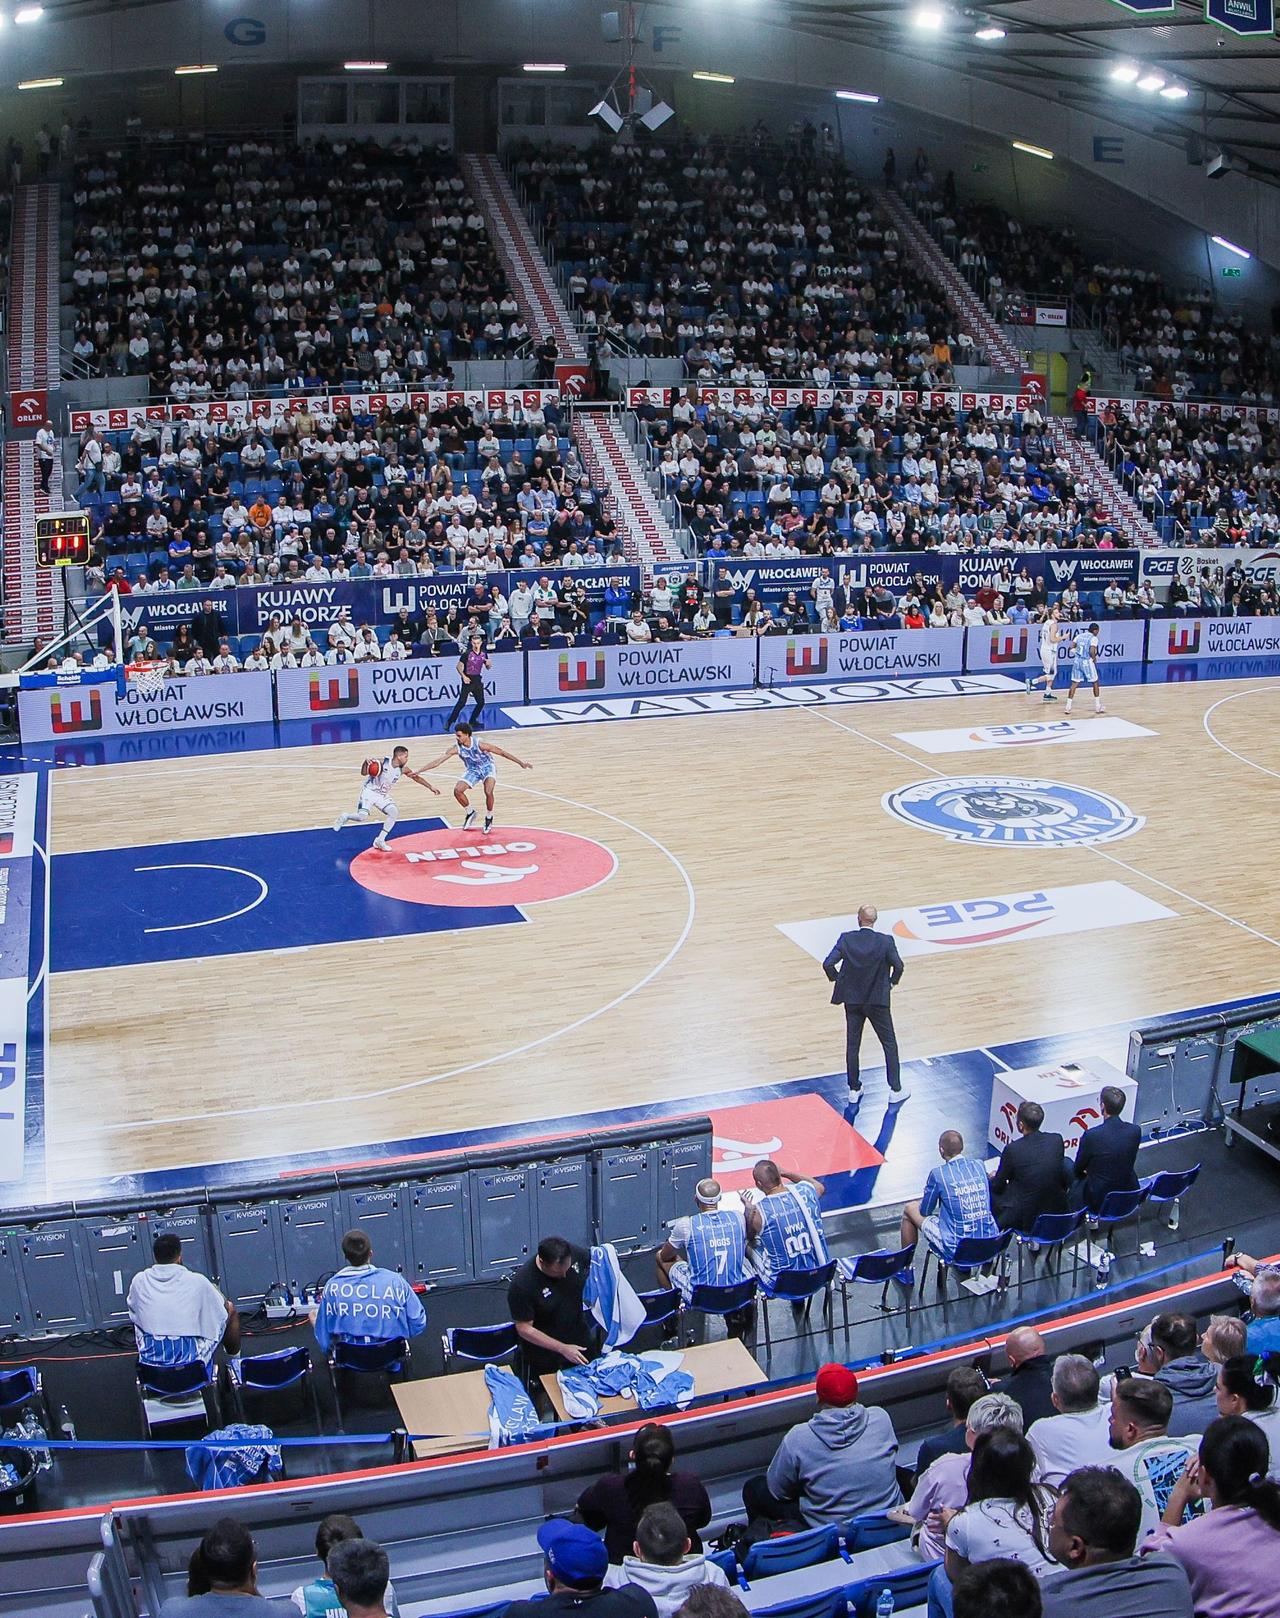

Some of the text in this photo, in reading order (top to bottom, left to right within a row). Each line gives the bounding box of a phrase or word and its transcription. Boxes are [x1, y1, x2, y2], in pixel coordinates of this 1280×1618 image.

[224, 18, 266, 46] G
[653, 26, 682, 52] F
[1093, 136, 1125, 163] E
[17, 414, 43, 422] ORLEN
[870, 562, 910, 573] POWIAT
[959, 557, 1018, 572] KUJAWY
[1081, 559, 1133, 569] WŁOCŁAWEK
[1149, 561, 1174, 572] PGE
[1197, 557, 1219, 565] Basket
[869, 575, 940, 587] WŁOCŁASKI
[419, 583, 468, 595] POWIAT
[257, 588, 336, 608] KUJAWY
[257, 605, 352, 626] POMORZE
[154, 624, 175, 632] Miasto
[1209, 622, 1252, 636] POWIAT
[839, 636, 897, 652] POWIAT
[619, 648, 683, 666] POWIAT
[839, 652, 941, 671] WŁOCŁAWSKI
[372, 664, 442, 684] POWIAT
[618, 665, 731, 686] WŁOCŁAWSKI
[115, 684, 187, 706] POWIAT
[373, 681, 496, 705] WŁOCŁAWKI
[541, 677, 1000, 720] MATSUOKA
[115, 701, 243, 727] WŁOCŁAWSKI
[985, 722, 1076, 737] PGE
[975, 814, 1117, 841] ANWIL
[404, 842, 536, 863] ORLEN
[919, 893, 1056, 927] PGE
[995, 1126, 1013, 1144] ORL
[674, 1143, 702, 1155] K-VISION
[619, 1153, 646, 1164] K-VISION
[553, 1164, 582, 1176] K-VISION
[495, 1173, 524, 1185] K-VISION
[366, 1191, 397, 1203] K-VISION
[426, 1184, 457, 1195] K-VISION
[236, 1209, 266, 1220] K-VISION
[297, 1202, 327, 1213] K-VISION
[166, 1218, 197, 1229] K-VISION
[784, 1222, 805, 1236] WYKA
[35, 1233, 66, 1243] K-VISION
[709, 1237, 731, 1248] DIGGS
[785, 1232, 812, 1259] 00
[714, 1250, 728, 1275] 7
[326, 1303, 405, 1321] AIRPORT
